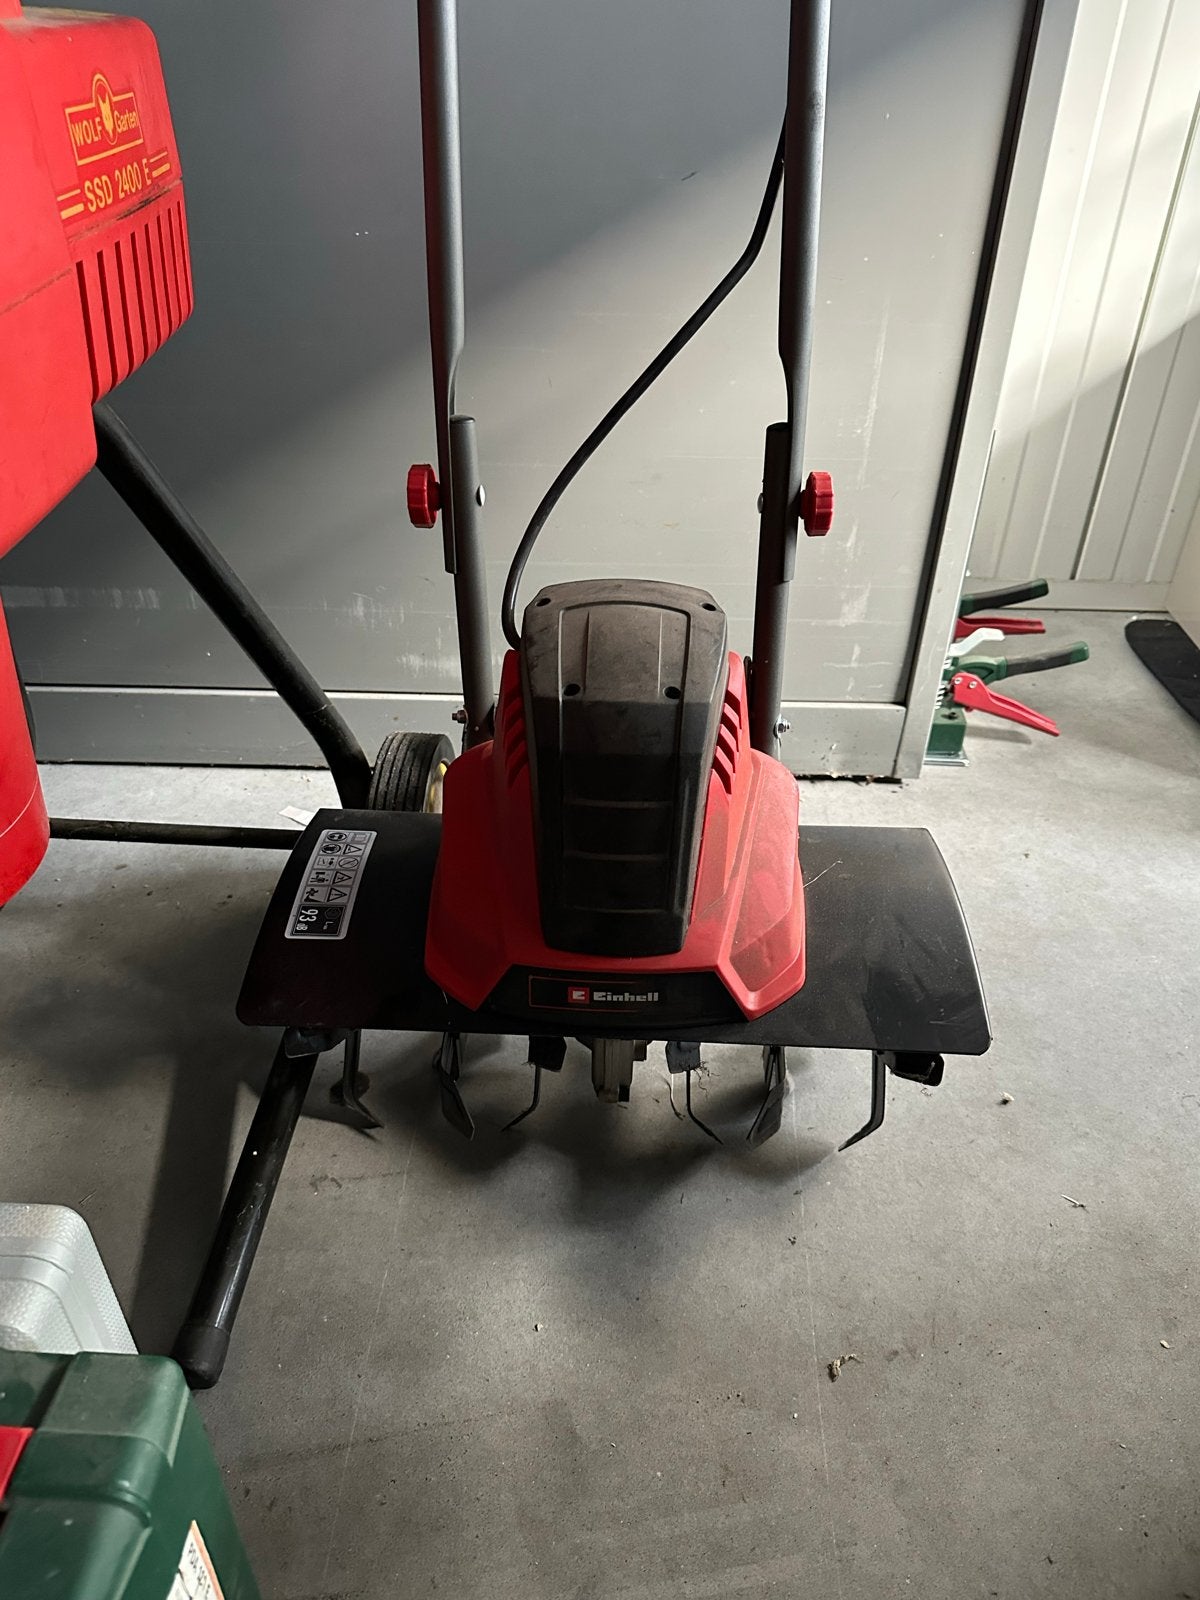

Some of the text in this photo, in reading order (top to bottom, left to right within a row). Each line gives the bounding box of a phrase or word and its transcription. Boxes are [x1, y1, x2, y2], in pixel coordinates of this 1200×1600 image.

[71, 108, 139, 146] WOLF Garten
[84, 157, 152, 213] SSD 2400 E
[299, 908, 319, 922] 93
[593, 991, 659, 1002] Einhell
